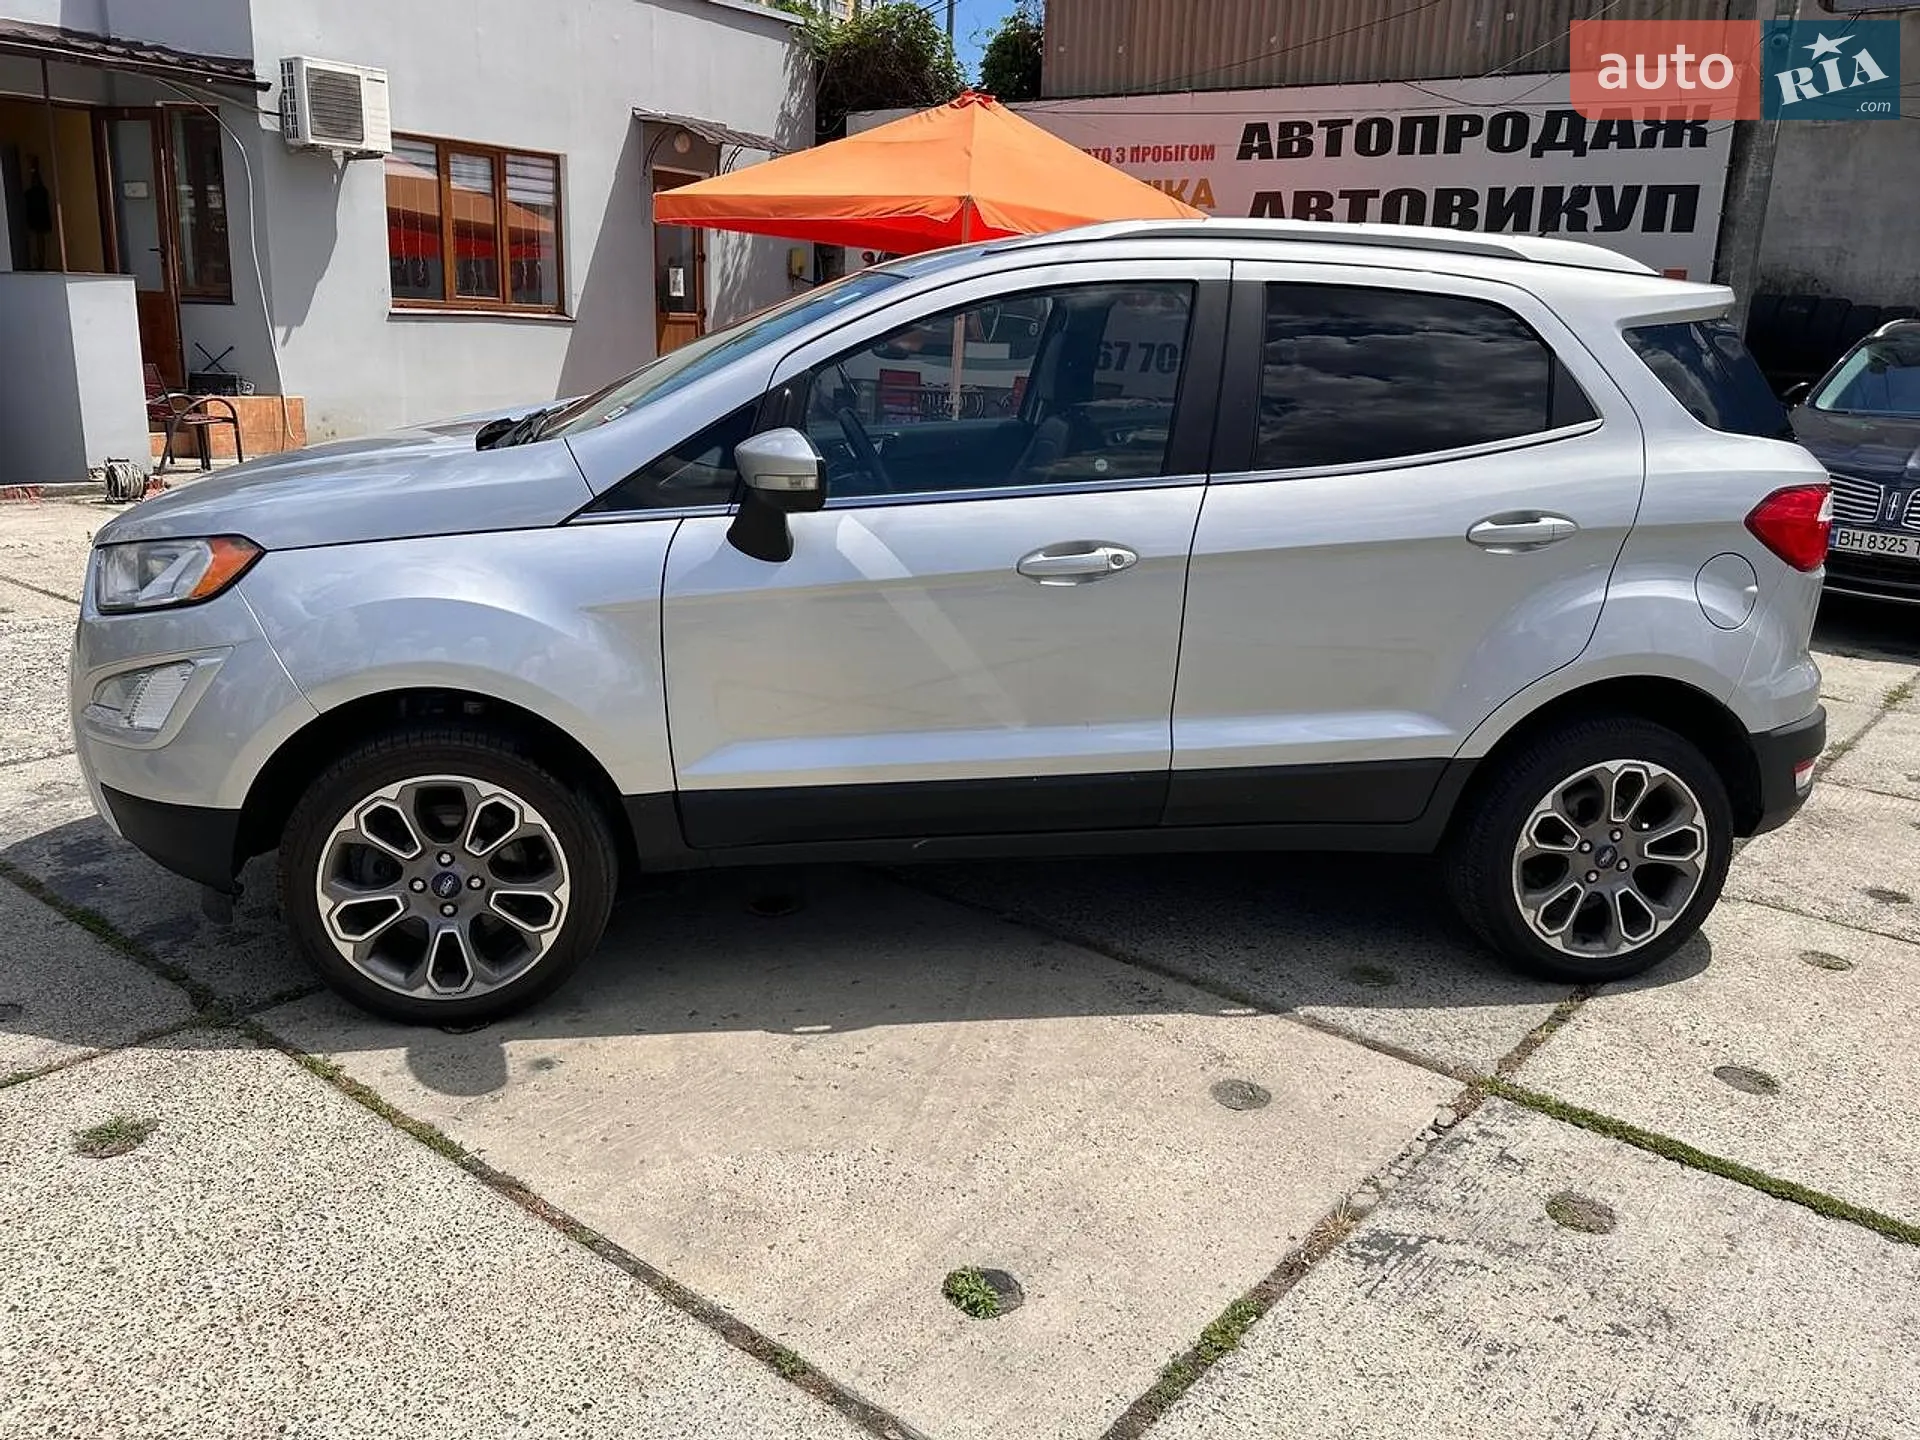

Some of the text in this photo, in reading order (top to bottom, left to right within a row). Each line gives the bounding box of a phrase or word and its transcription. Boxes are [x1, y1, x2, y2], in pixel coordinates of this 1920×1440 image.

[1236, 104, 1713, 160] АВТОПРОДАЖ
[1130, 144, 1216, 163] ПРОБІГОМ
[1248, 184, 1701, 233] АВТОВИКУП
[1138, 342, 1178, 374] 70
[1839, 531, 1865, 547] BH
[1867, 535, 1908, 553] 8325
